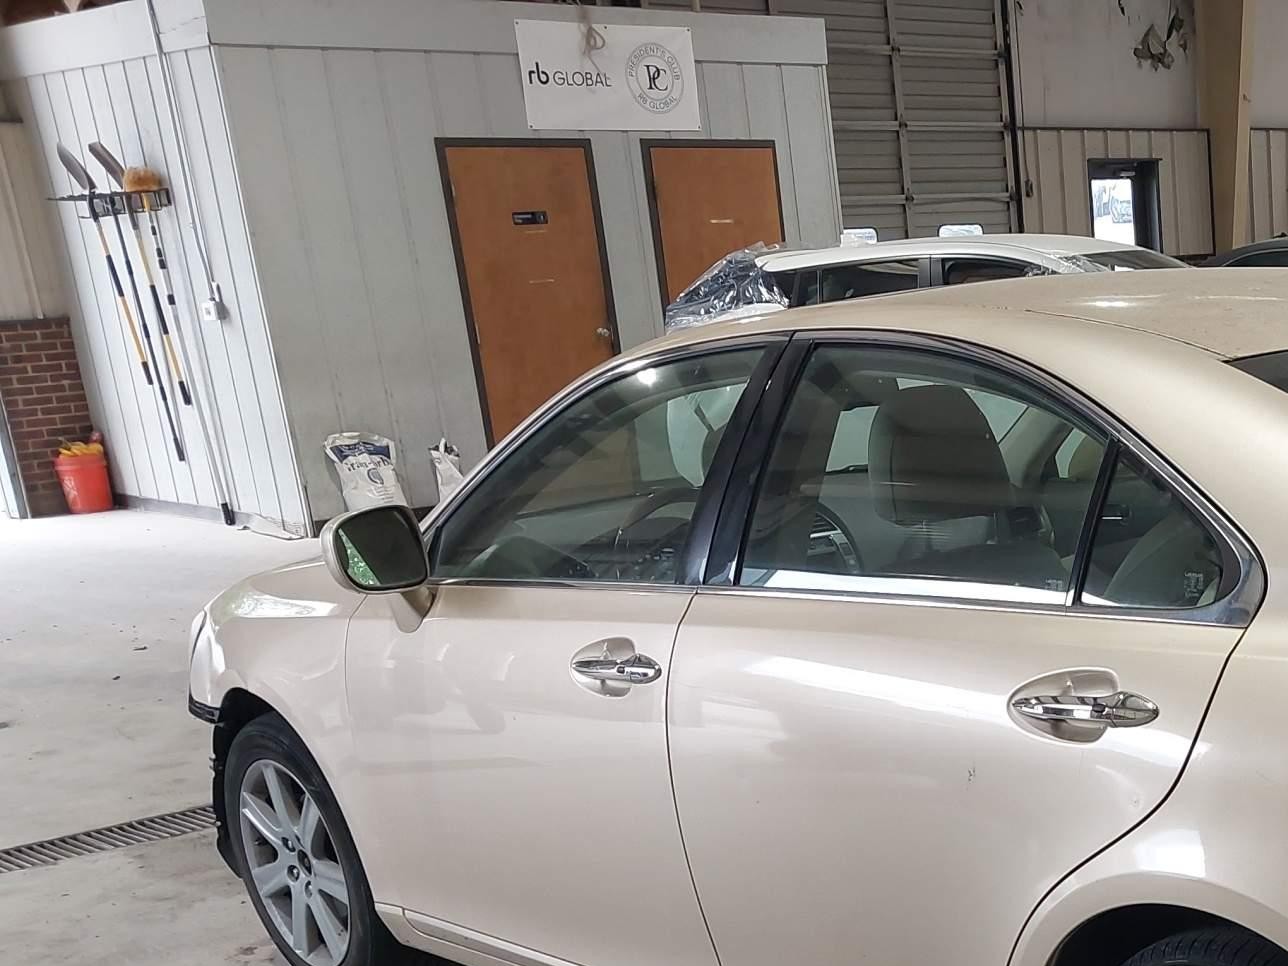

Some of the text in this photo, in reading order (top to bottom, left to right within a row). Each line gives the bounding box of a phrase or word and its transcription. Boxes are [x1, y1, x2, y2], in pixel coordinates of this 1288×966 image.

[528, 62, 612, 87] rb GLOBAL
[667, 55, 681, 81] CLUB
[648, 95, 678, 110] GLOBAL
